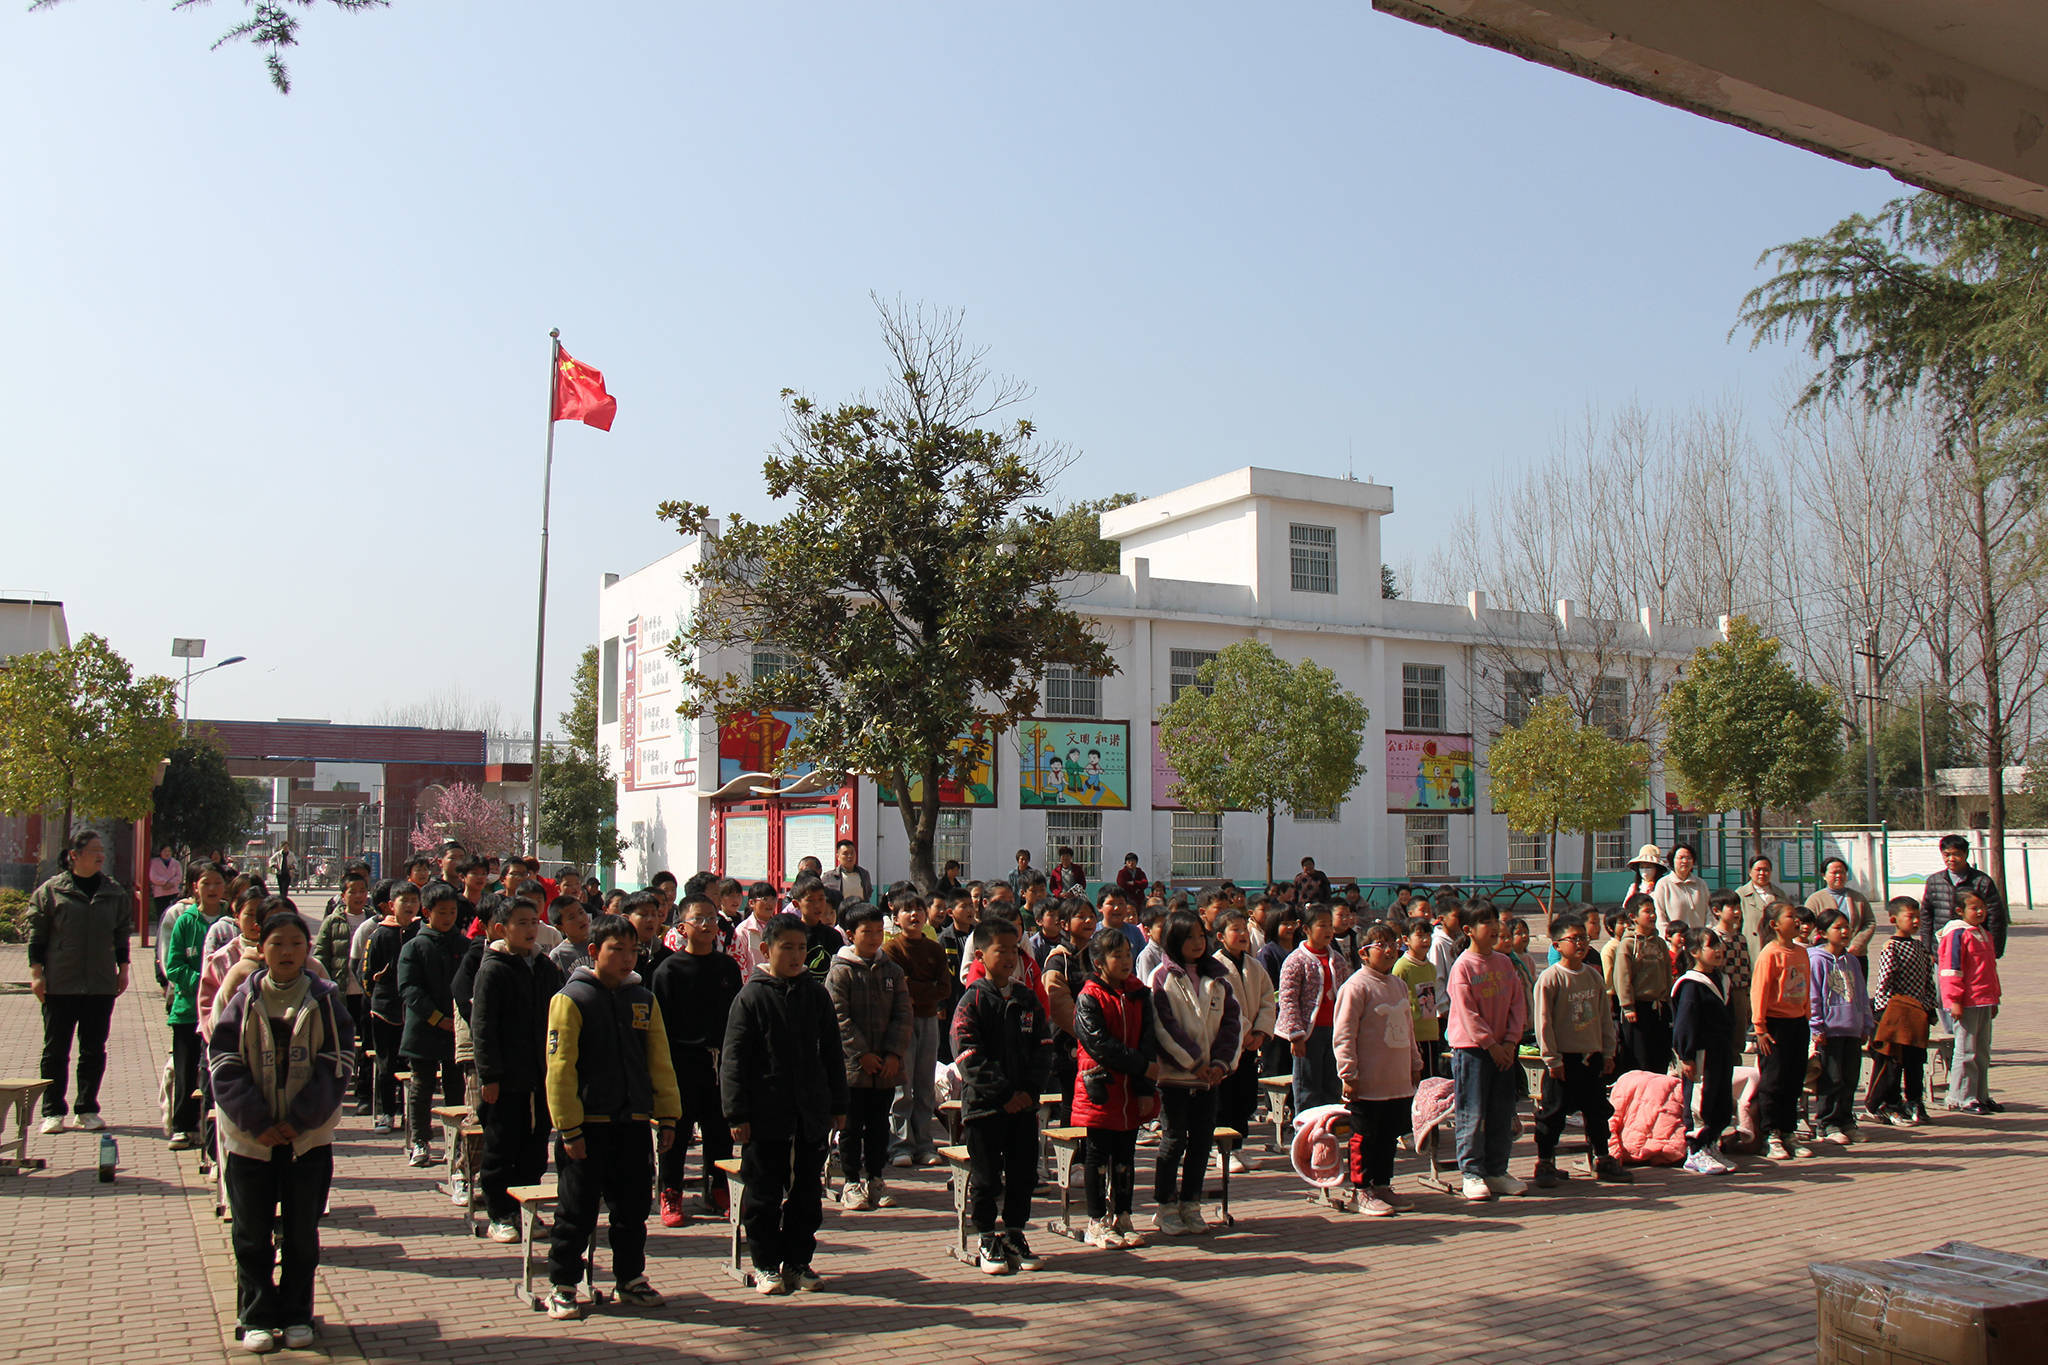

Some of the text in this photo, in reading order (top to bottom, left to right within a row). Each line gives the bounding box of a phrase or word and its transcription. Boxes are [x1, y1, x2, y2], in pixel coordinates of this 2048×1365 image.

[1065, 728, 1121, 747] 文明和谐
[839, 792, 851, 834] 从小
